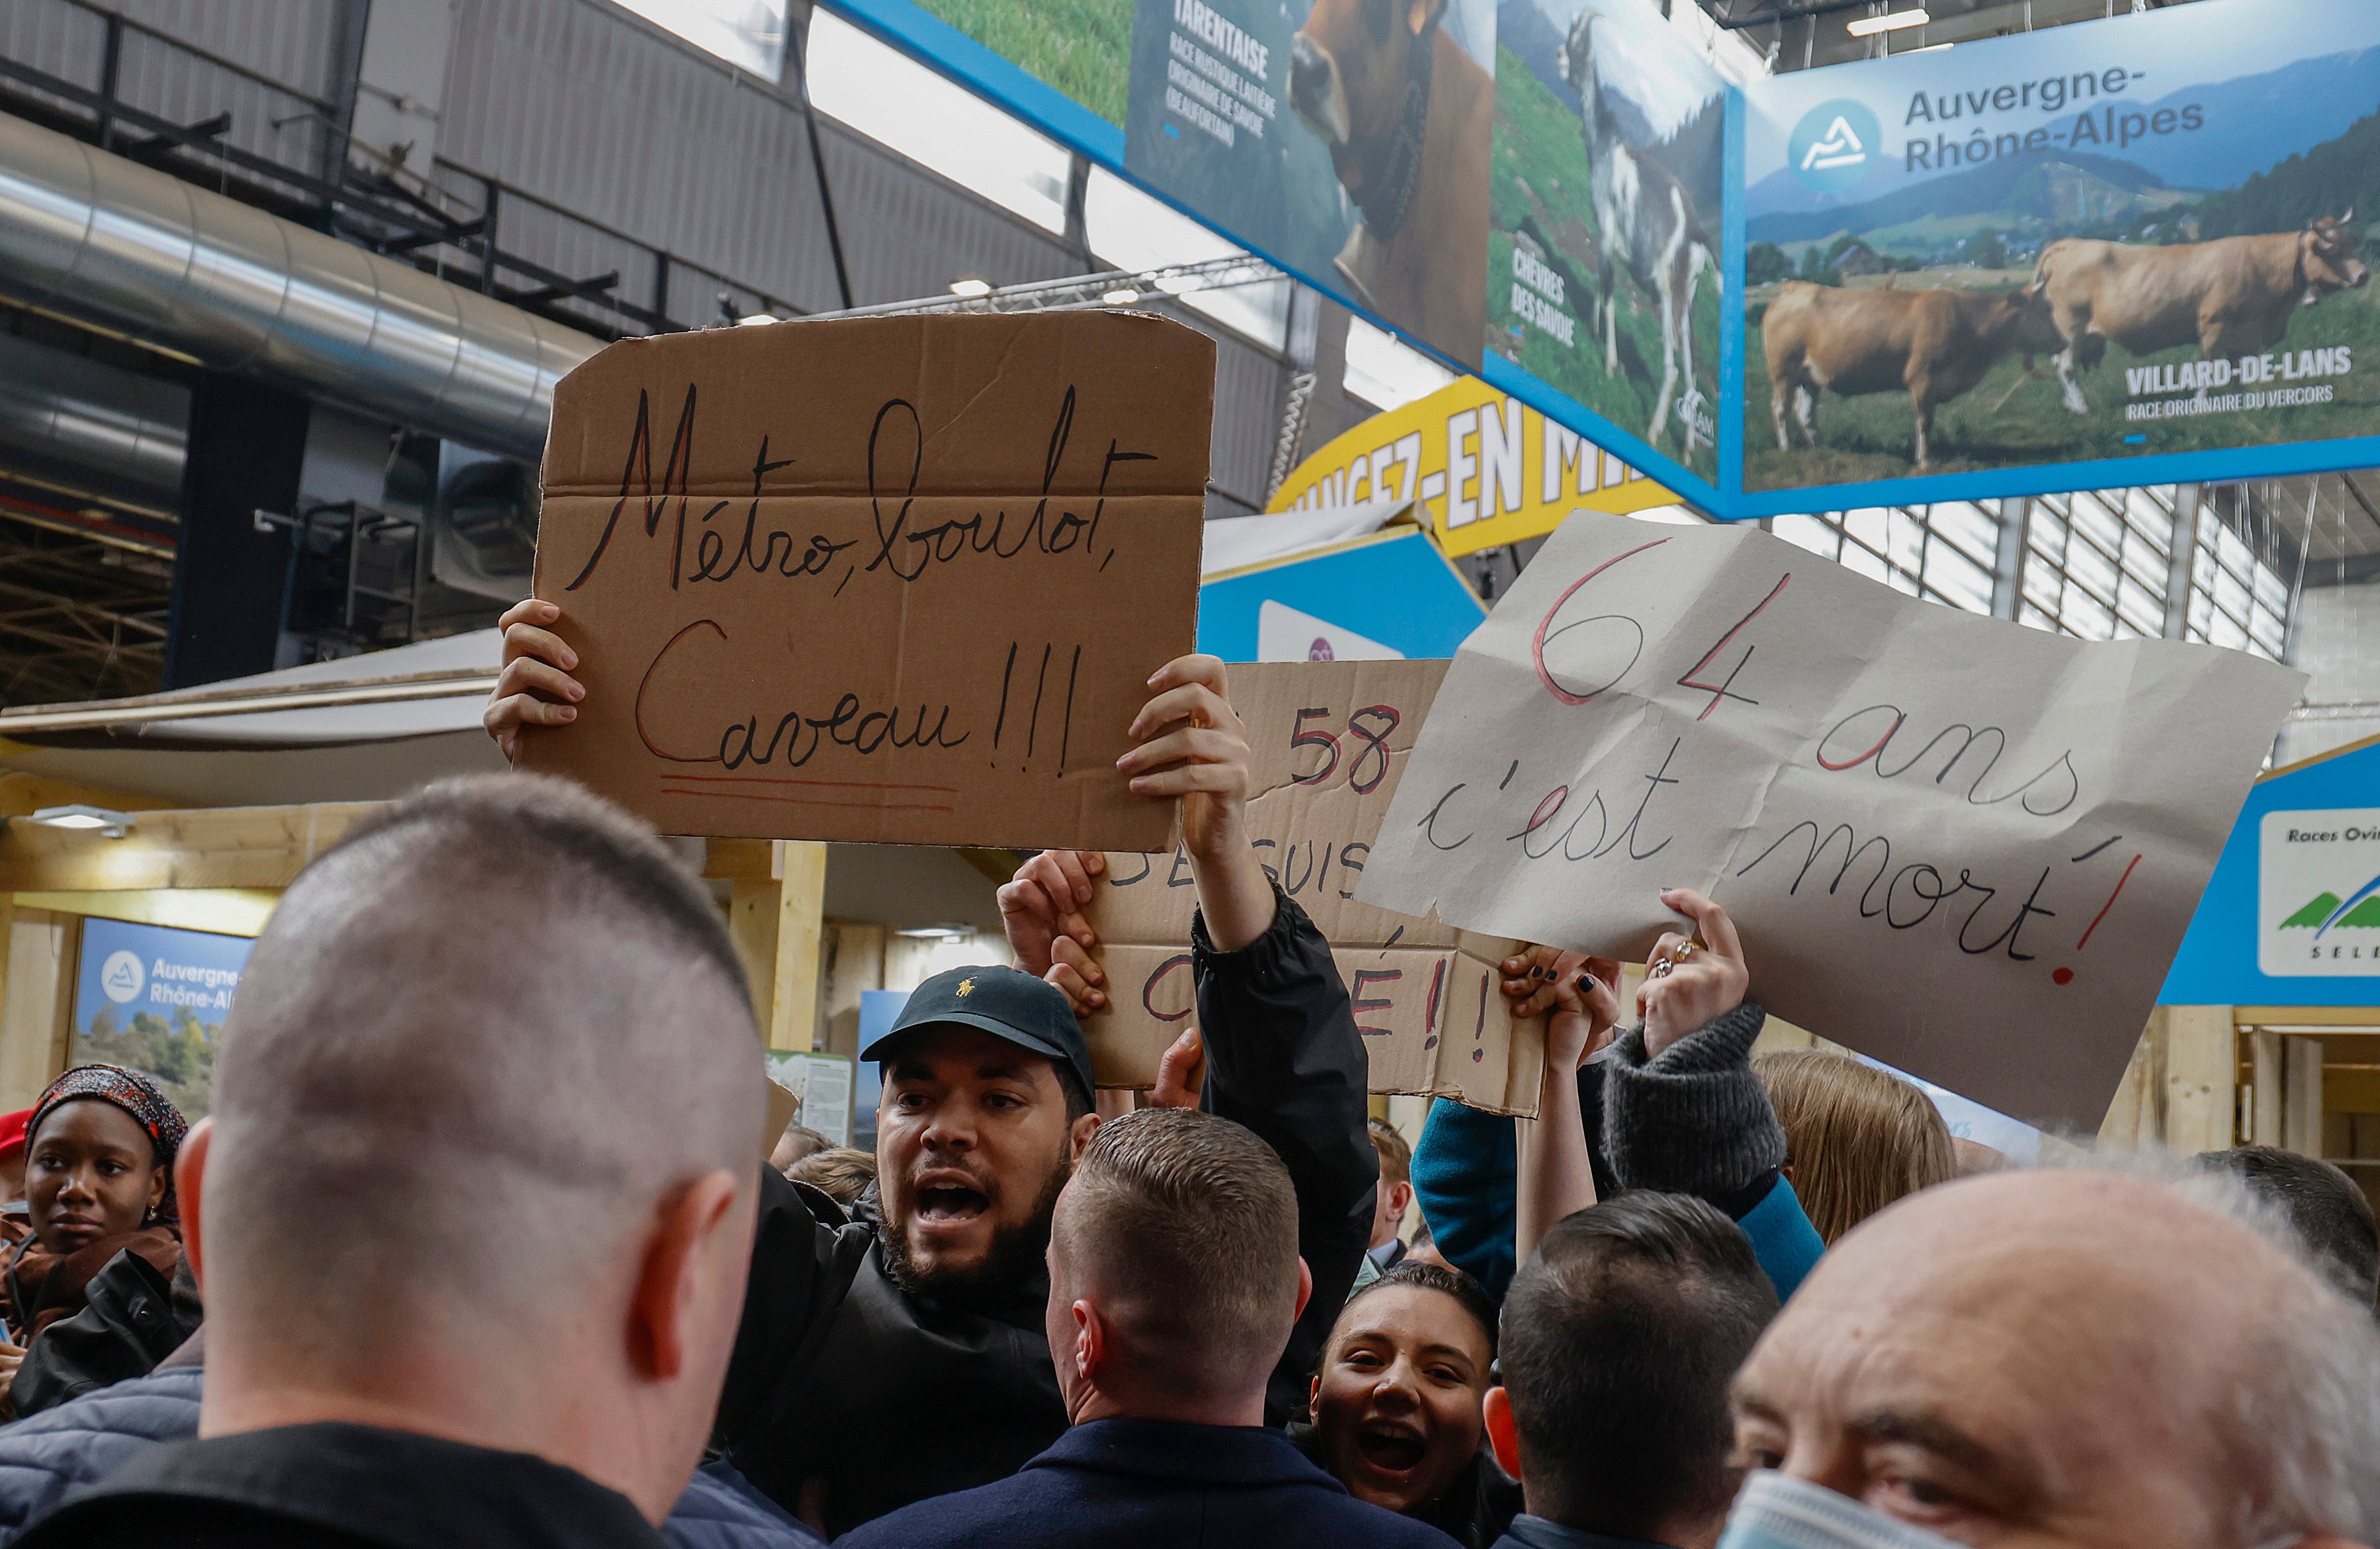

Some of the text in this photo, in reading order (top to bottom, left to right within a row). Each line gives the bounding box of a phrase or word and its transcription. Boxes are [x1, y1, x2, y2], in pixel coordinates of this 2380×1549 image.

[1169, 31, 1195, 66] RACE
[1219, 92, 1233, 119] DE
[1905, 66, 2146, 126] Auvergne-
[1905, 102, 2205, 173] Rhône-Alpes
[1512, 248, 1564, 305] CHÈVRES
[1511, 282, 1574, 345] DES SAVOIE
[2126, 346, 2352, 396] VILLARD-DE-LANS
[2126, 384, 2334, 422] RACE ORIGINAIRE DU VERCORS
[564, 382, 1158, 598] Métro, boulot,
[1531, 536, 2079, 816] 64 ans
[1291, 704, 1400, 795] 58
[1417, 737, 1681, 862] c'est
[2287, 829, 2338, 843] Races
